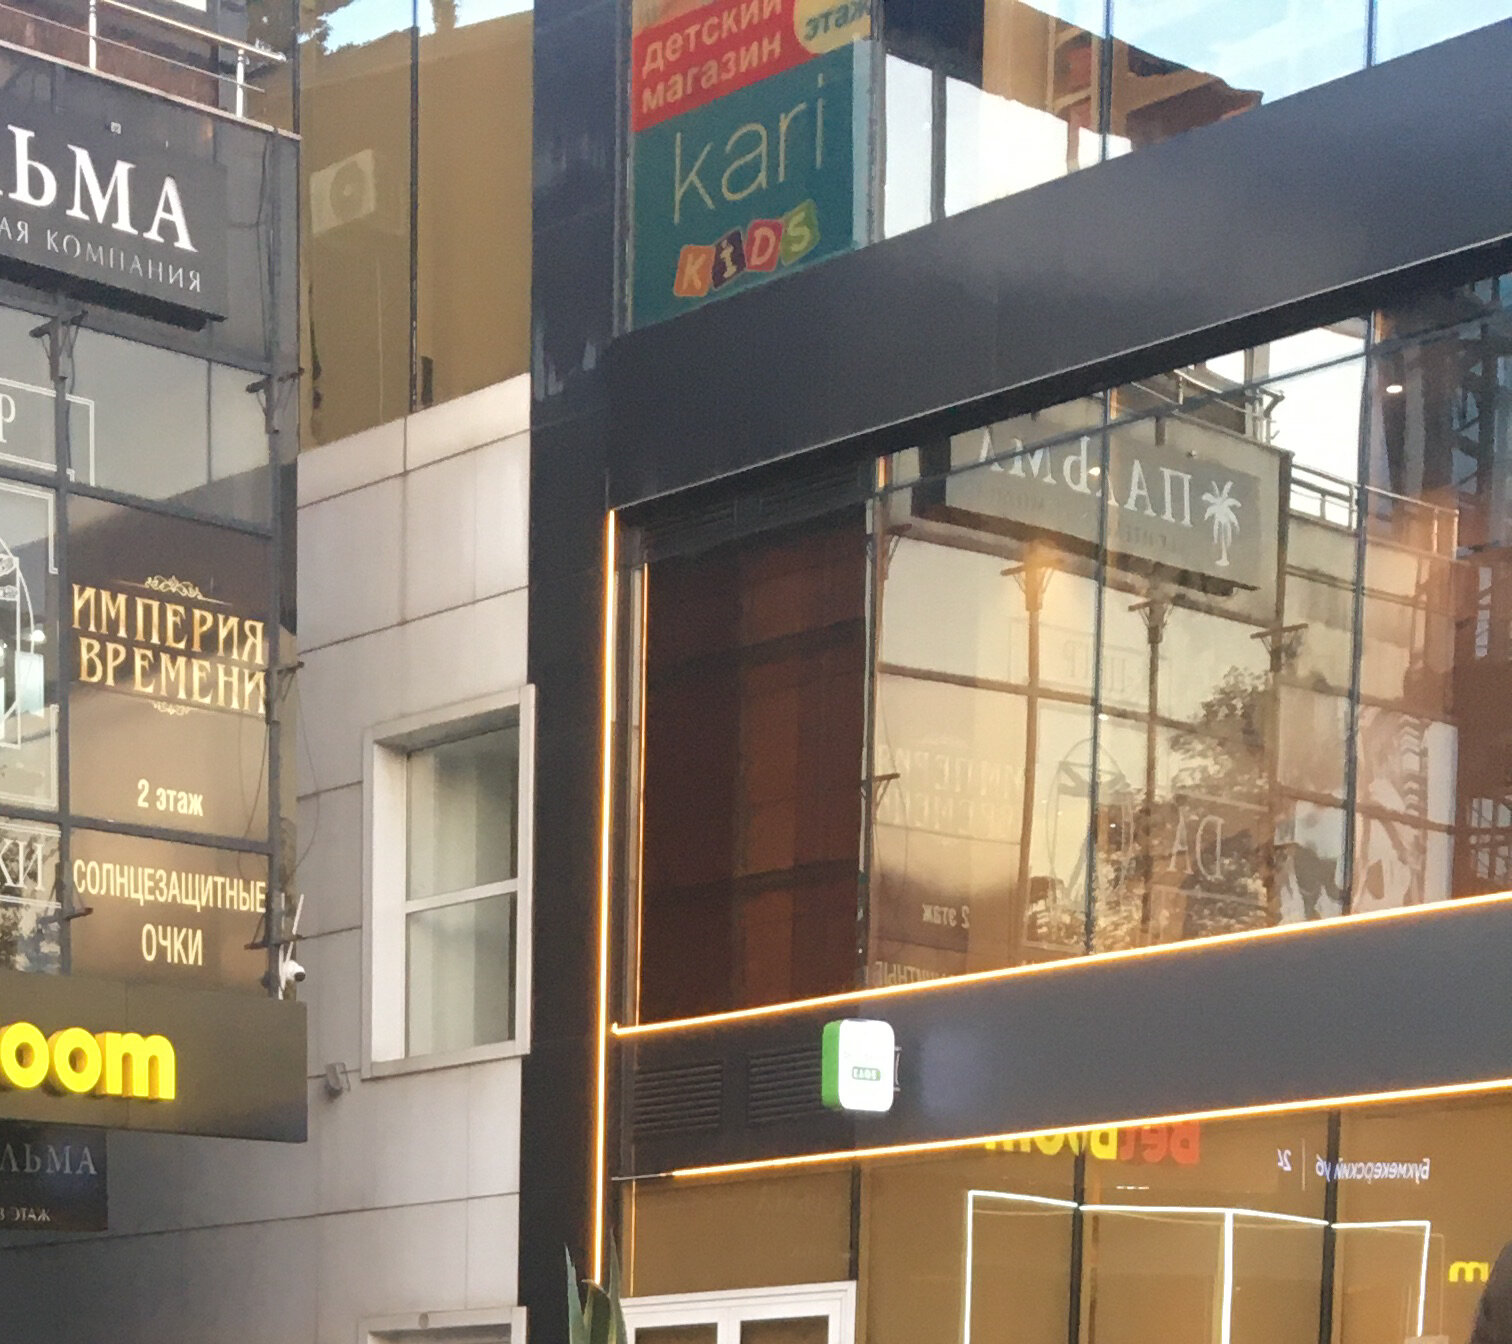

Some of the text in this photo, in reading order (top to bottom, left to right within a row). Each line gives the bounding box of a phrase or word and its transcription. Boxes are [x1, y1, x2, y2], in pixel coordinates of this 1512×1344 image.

[641, 0, 783, 79] детский
[642, 31, 782, 114] магазин
[673, 73, 824, 226] kari
[47, 229, 201, 292] КОМПАНИЯ
[72, 583, 265, 665] ИМПЕРИЯ
[79, 636, 266, 714] ВРЕМЕНИ
[137, 778, 204, 817] 2 этаж
[73, 858, 267, 914] СОЛНЦЕЗАЩИТНЫЕ
[141, 923, 204, 966] ОЧКИ
